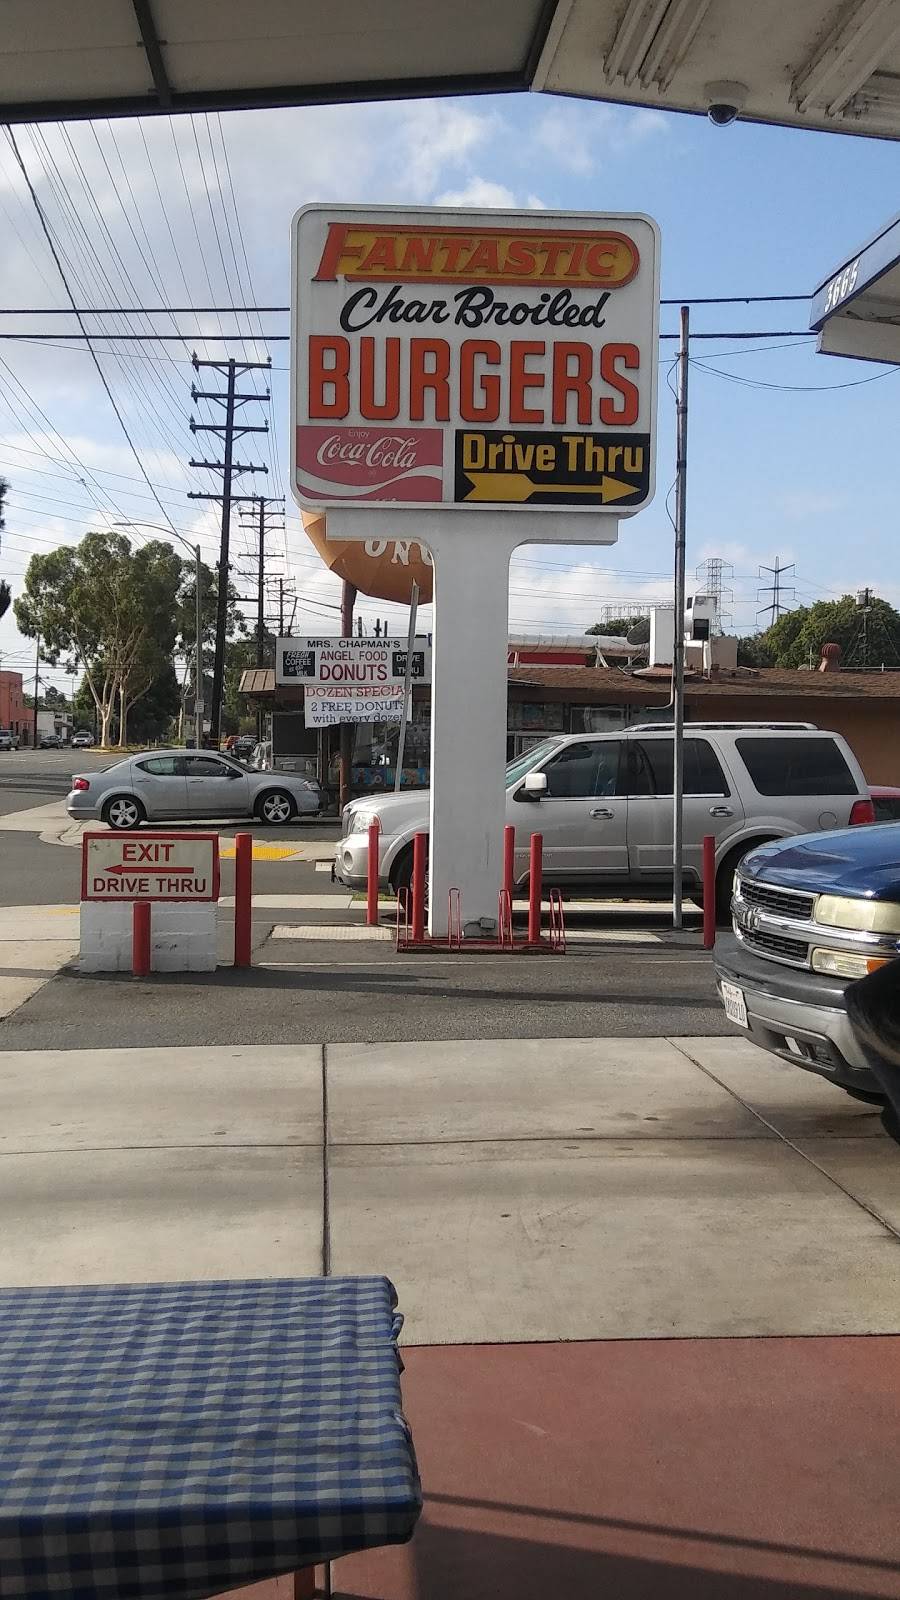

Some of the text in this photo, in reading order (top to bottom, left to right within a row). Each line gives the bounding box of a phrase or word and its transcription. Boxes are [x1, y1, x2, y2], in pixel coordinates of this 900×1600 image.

[311, 222, 628, 283] FANTASTIC
[824, 258, 861, 313] 3665
[339, 285, 612, 332] Char Broiled
[308, 335, 640, 425] BURGERS
[348, 430, 370, 438] Enjoy
[317, 434, 420, 468] Coca-Cola
[462, 433, 643, 473] Drive Thru
[307, 640, 401, 649] MRS. CHAPMAN'S
[285, 658, 312, 666] COFFEE
[319, 650, 388, 662] ANGEL FOOD
[319, 664, 388, 681] DONUTS
[305, 685, 412, 698] DOZEN SPECIA
[311, 701, 318, 712] 2
[321, 701, 352, 713] FREE
[312, 713, 403, 723] with every doze
[122, 843, 175, 862] EXIT
[93, 877, 207, 893] DRIVE THRU
